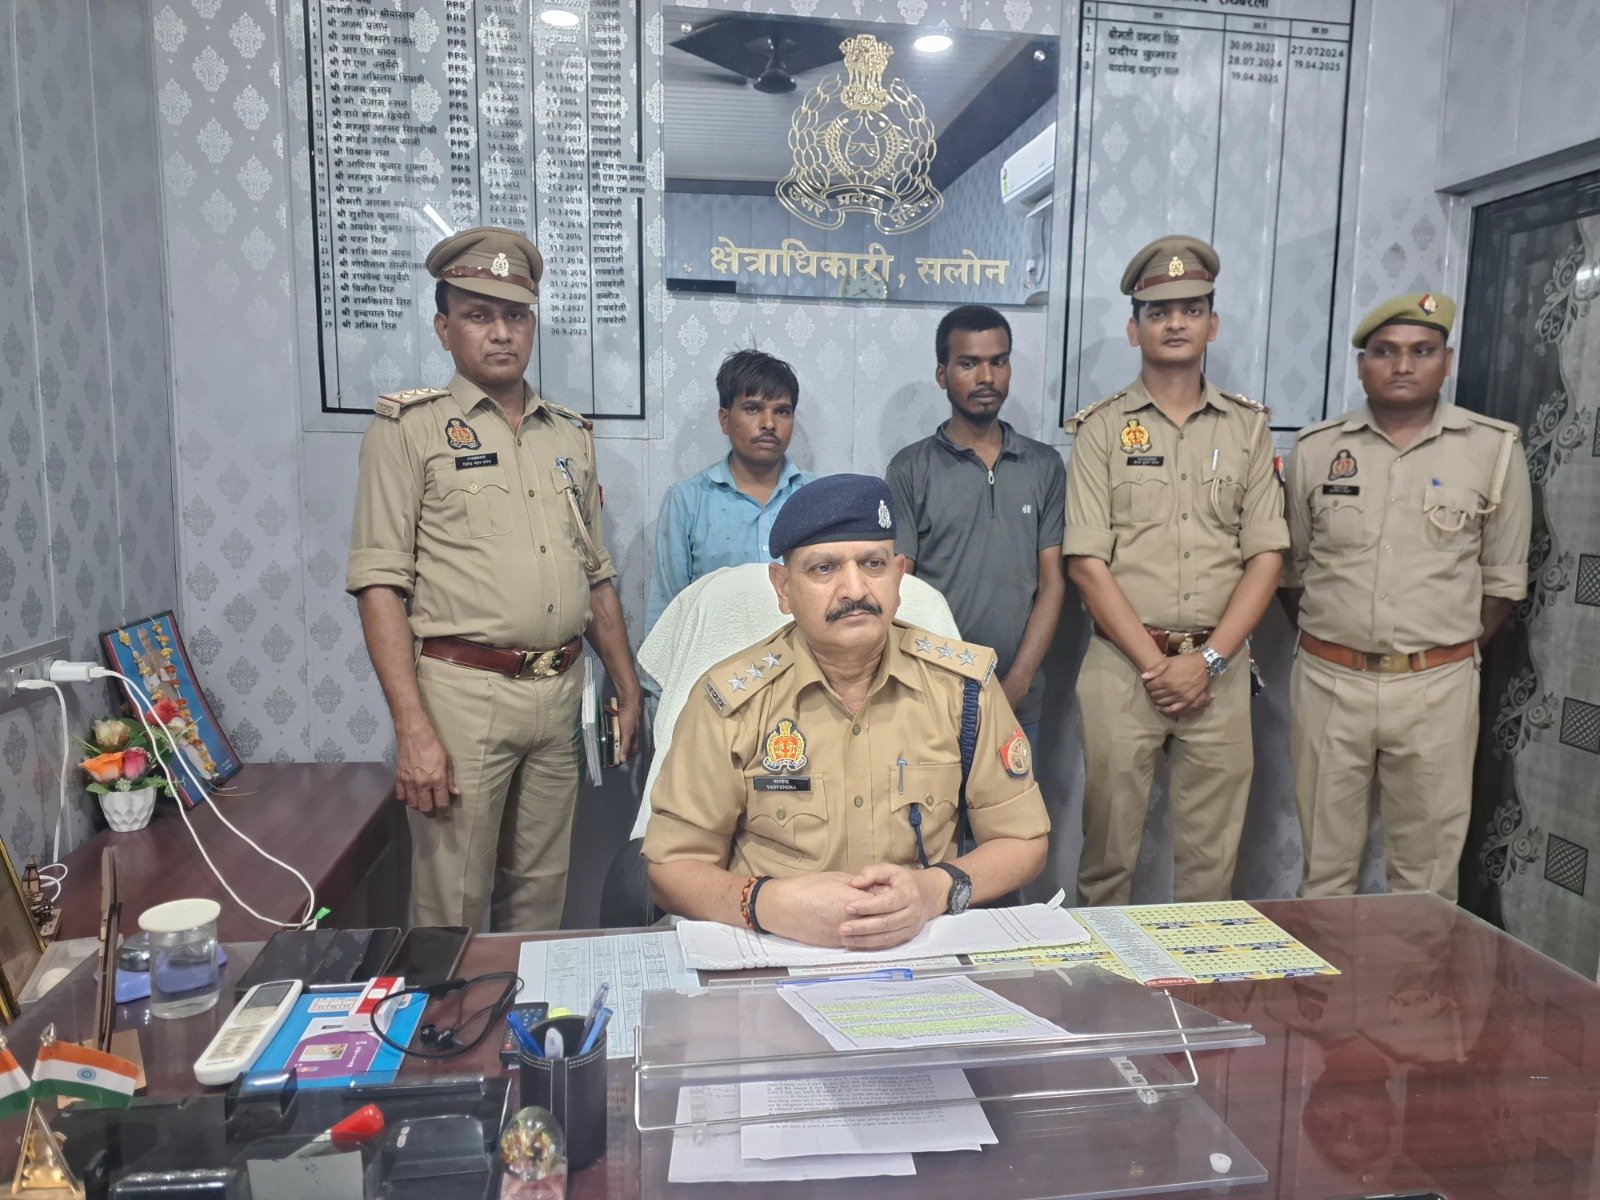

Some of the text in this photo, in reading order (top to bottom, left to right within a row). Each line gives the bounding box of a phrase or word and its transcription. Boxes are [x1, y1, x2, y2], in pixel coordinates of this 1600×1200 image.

[449, 89, 468, 97] PPS
[449, 102, 468, 110] PPS
[451, 152, 470, 160] PPS
[451, 164, 470, 172] PPS
[915, 248, 1010, 286] सलोन
